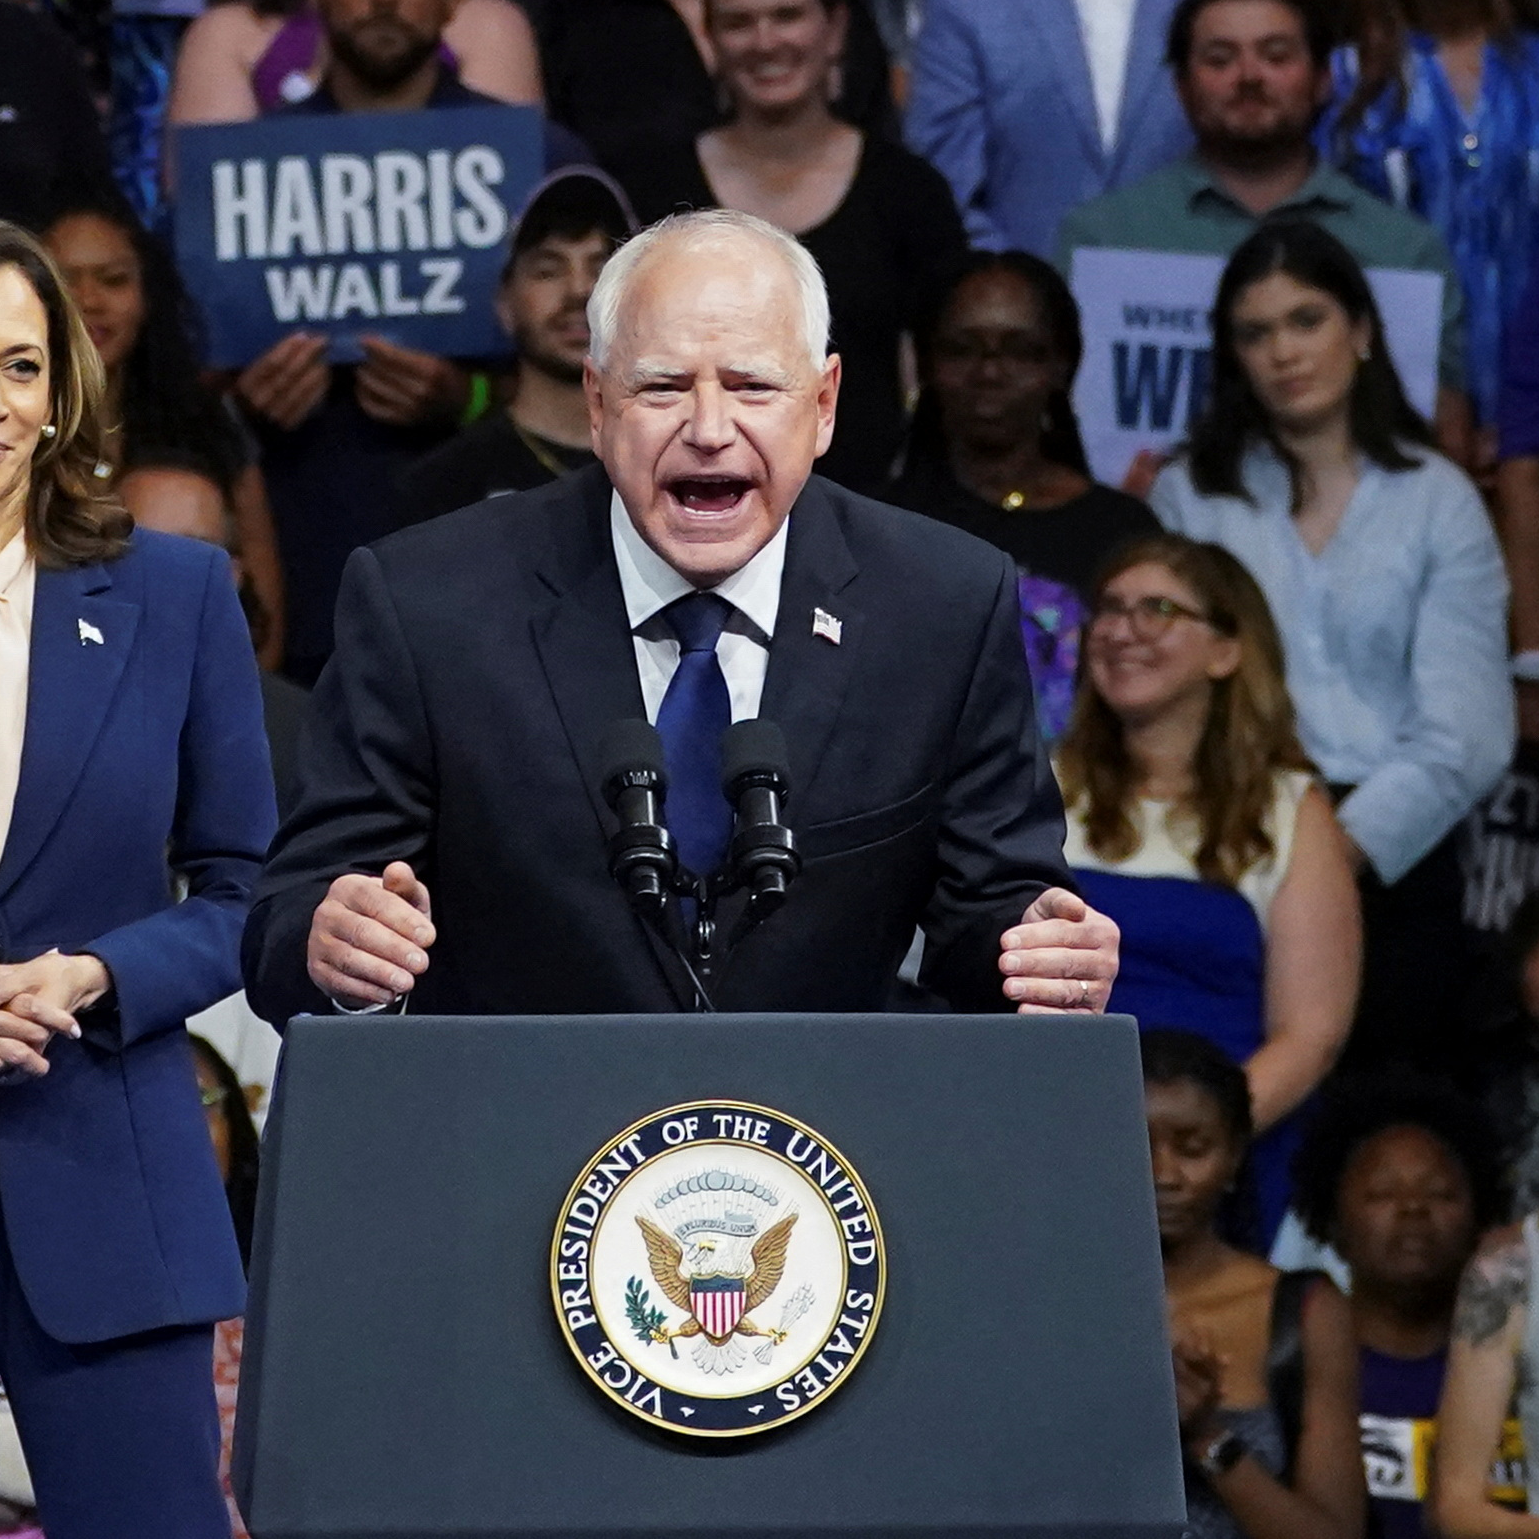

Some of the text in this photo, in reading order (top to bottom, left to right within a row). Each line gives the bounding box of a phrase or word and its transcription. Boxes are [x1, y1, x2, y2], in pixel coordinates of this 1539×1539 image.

[212, 145, 508, 260] HARRIS
[266, 261, 466, 323] WALZ
[559, 1113, 877, 1418] VICE PRESIDENT OF THE UNITED STATES
